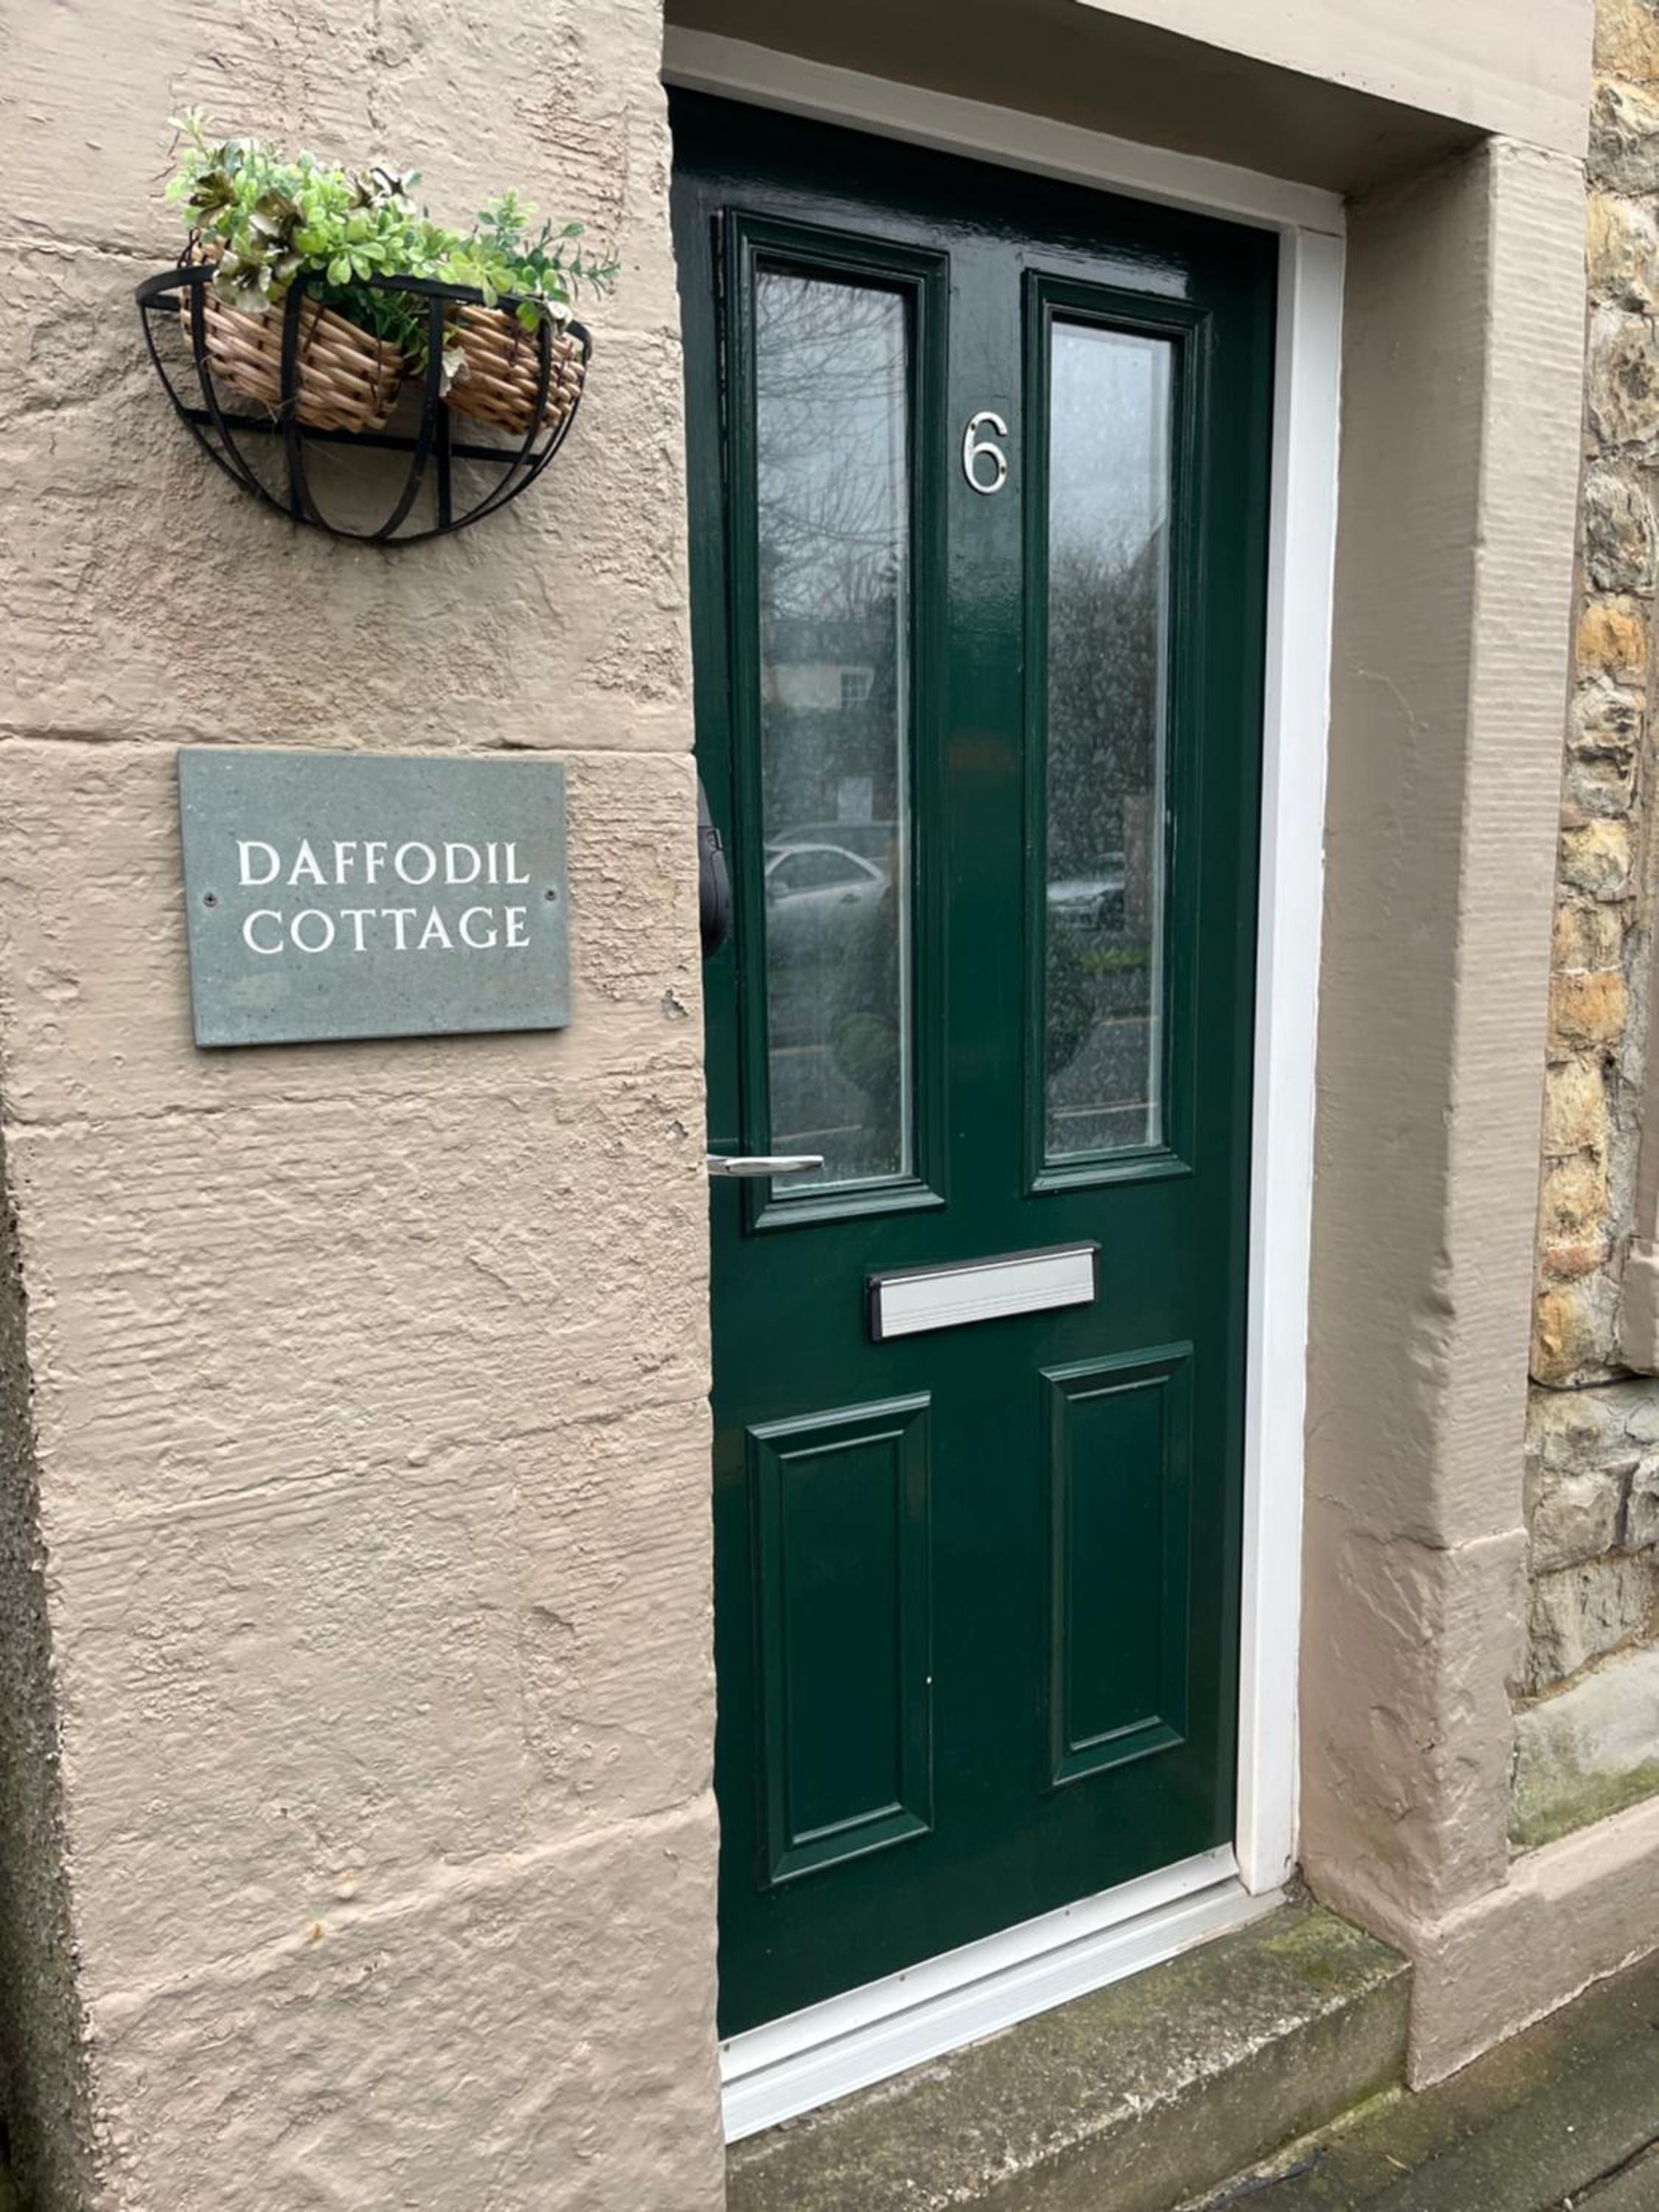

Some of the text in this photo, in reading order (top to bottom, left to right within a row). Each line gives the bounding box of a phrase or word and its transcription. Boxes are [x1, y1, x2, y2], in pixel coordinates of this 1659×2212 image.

[961, 411, 1008, 495] 6
[236, 839, 530, 886] DAFFODIL
[243, 905, 530, 954] COTTAGE
